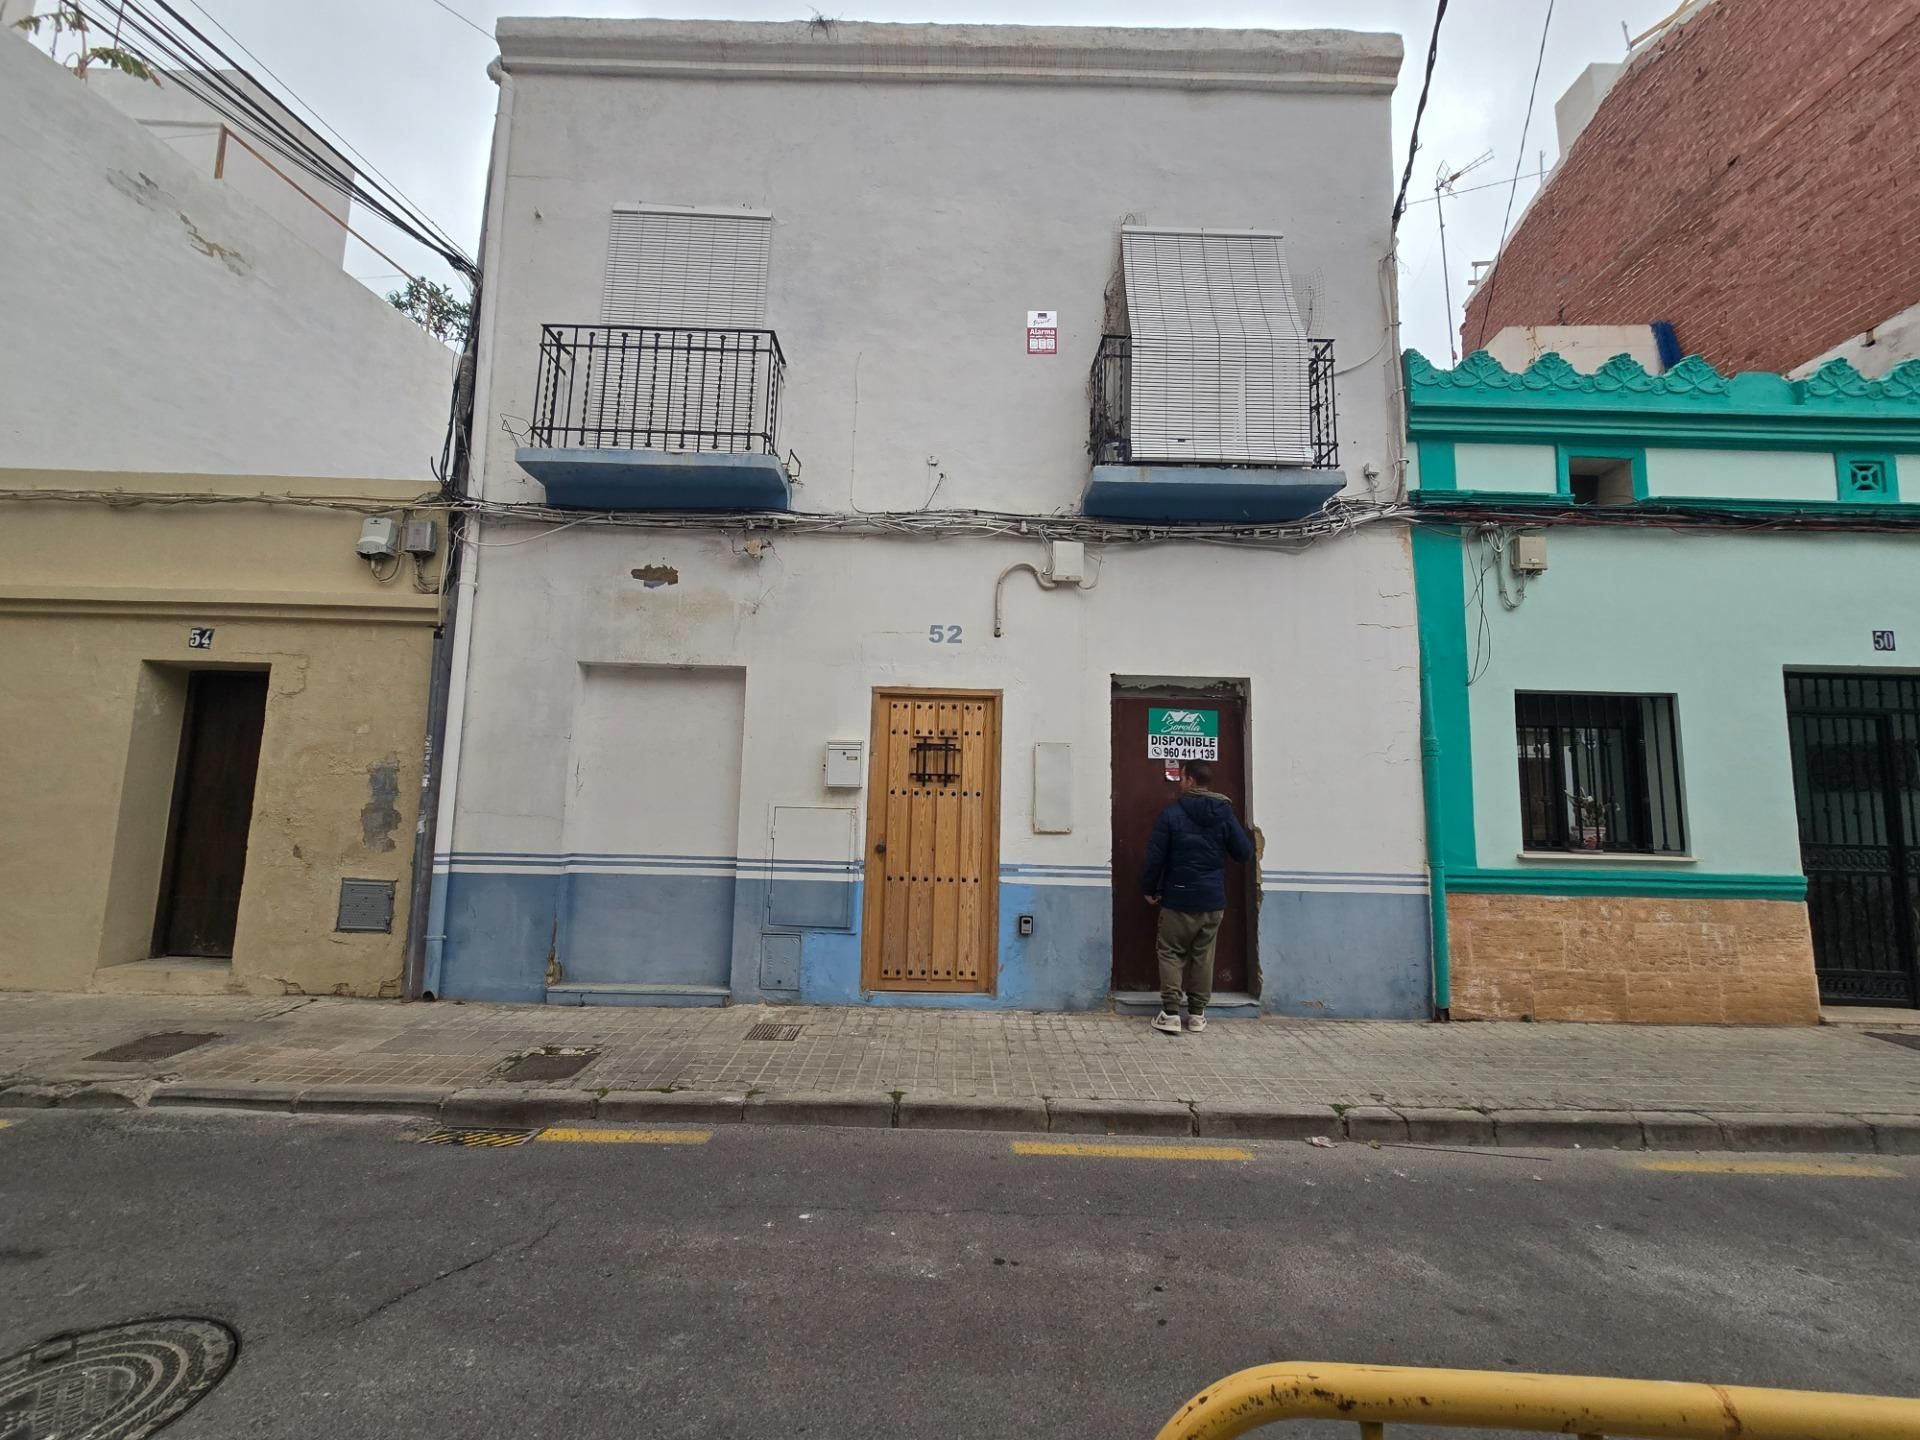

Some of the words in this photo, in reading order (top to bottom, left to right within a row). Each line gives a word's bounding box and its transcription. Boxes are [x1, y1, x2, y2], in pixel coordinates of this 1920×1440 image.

[190, 629, 211, 648] 54
[929, 624, 962, 644] 52
[1874, 631, 1894, 650] 50
[1151, 735, 1216, 748] DISPONIBLE
[1163, 747, 1180, 758] 960
[1181, 748, 1196, 758] 411
[1200, 748, 1215, 759] 139
